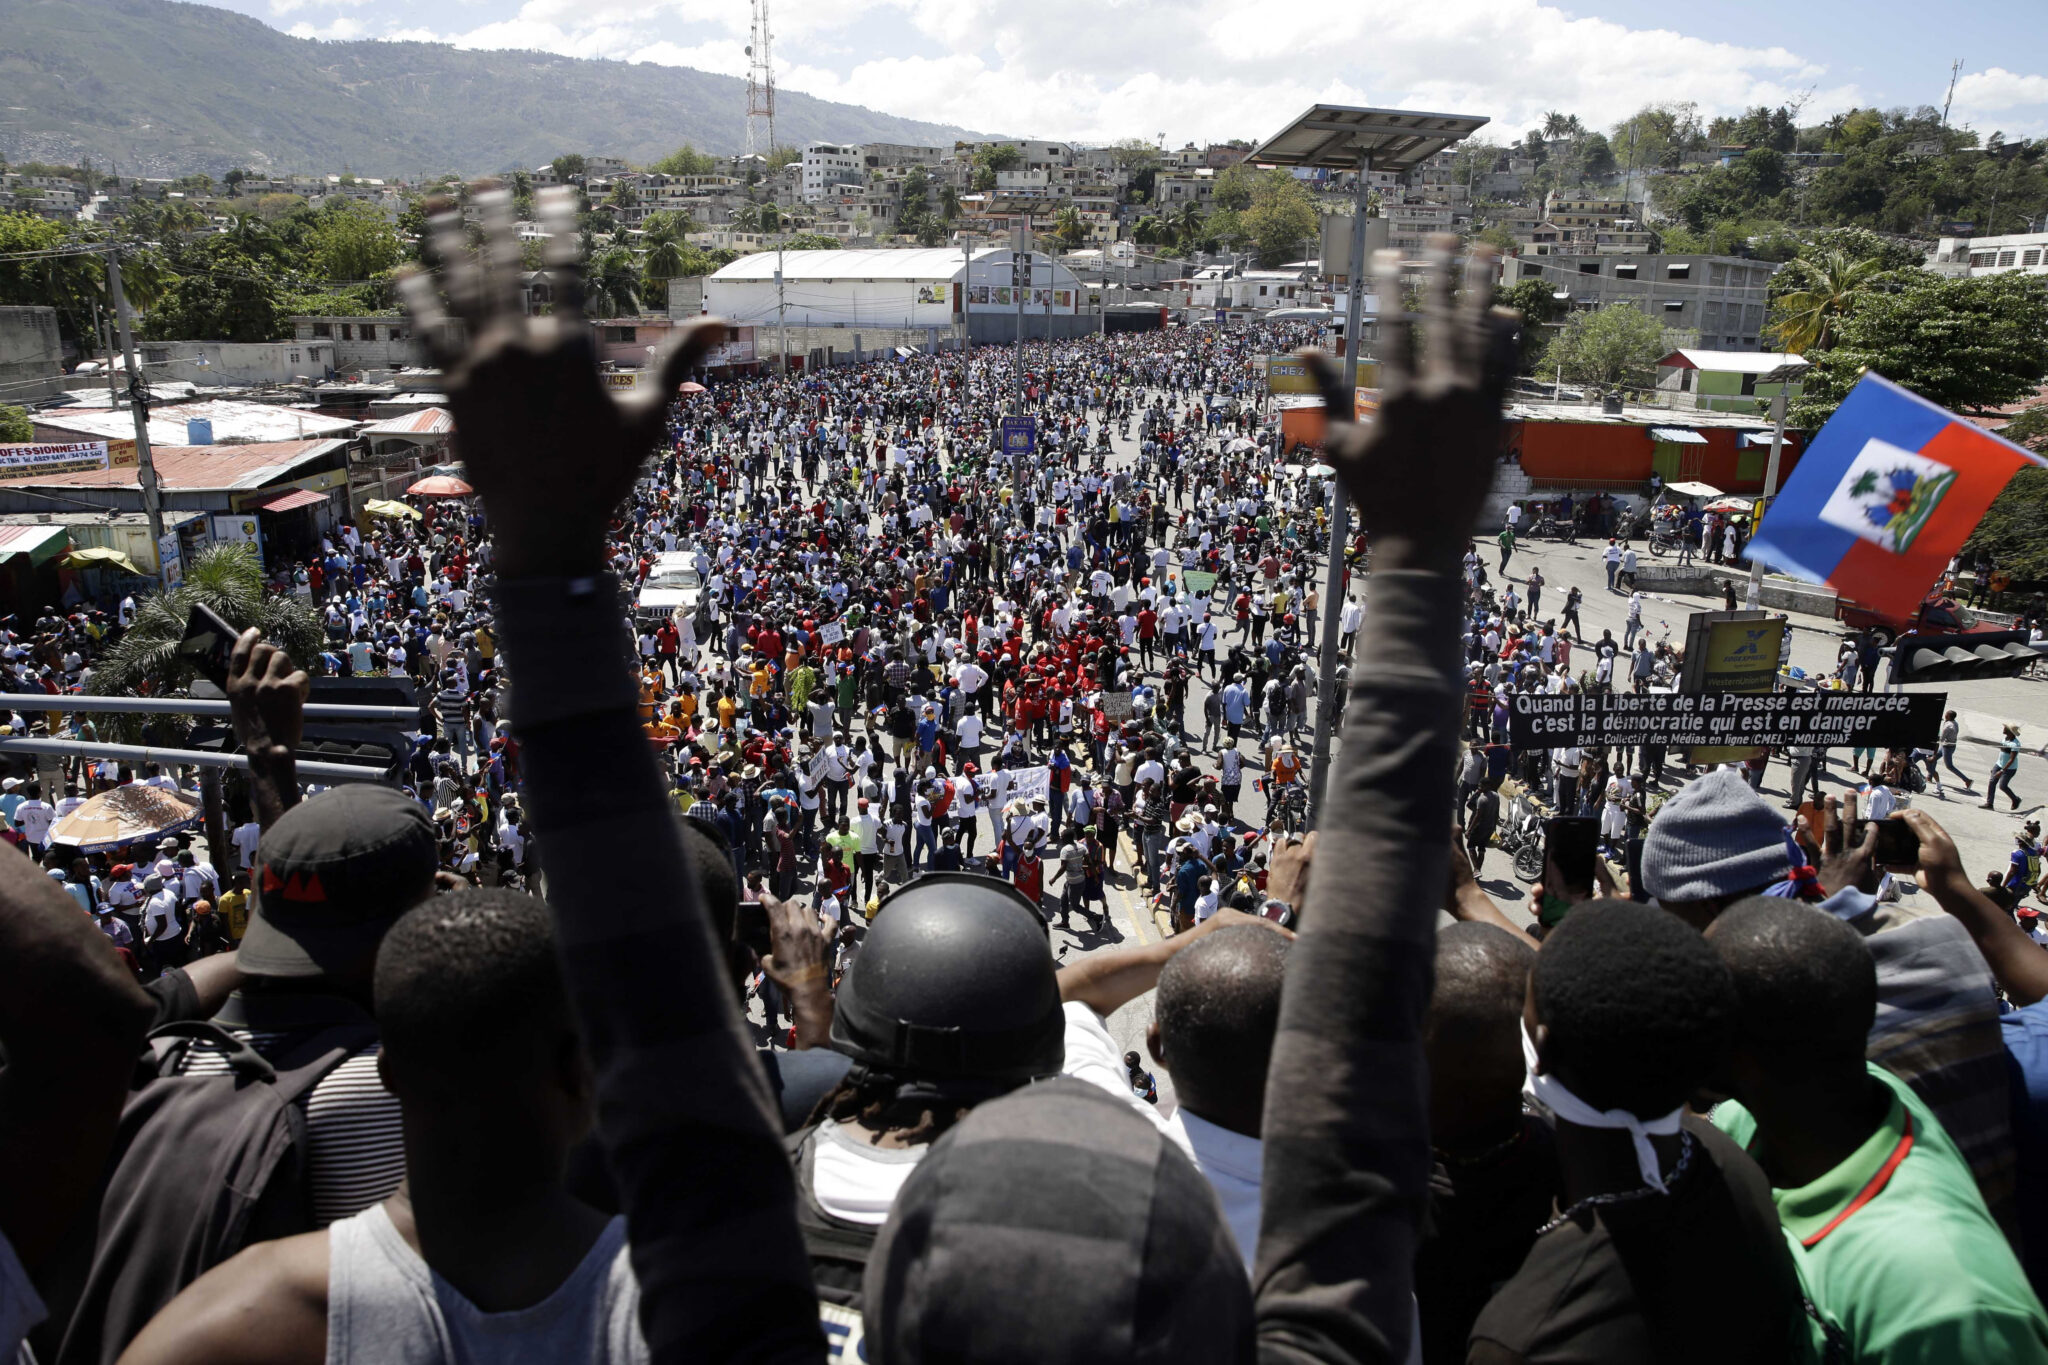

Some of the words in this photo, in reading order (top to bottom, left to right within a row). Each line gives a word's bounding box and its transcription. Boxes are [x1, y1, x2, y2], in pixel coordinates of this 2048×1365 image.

[1271, 366, 1305, 376] CHEZ
[114, 455, 135, 465] Cours
[1516, 694, 1575, 714] Quand
[1580, 694, 1597, 712] la
[1602, 694, 1667, 712] Liberté
[1672, 694, 1695, 712] de
[1699, 694, 1716, 712] la
[1720, 693, 1788, 712] Presse
[1790, 692, 1822, 711] est
[1825, 693, 1911, 715] menacée,
[1531, 713, 1576, 734] c'est
[1581, 713, 1597, 731] la
[1602, 712, 1704, 731] démocratie
[1709, 713, 1737, 735] qui
[1741, 712, 1773, 731] est
[1778, 715, 1801, 731] en
[1809, 712, 1877, 733] danger
[1650, 733, 1668, 744] des
[1670, 732, 1707, 744] Médias
[1709, 736, 1722, 745] en
[1724, 734, 1750, 747] ligne
